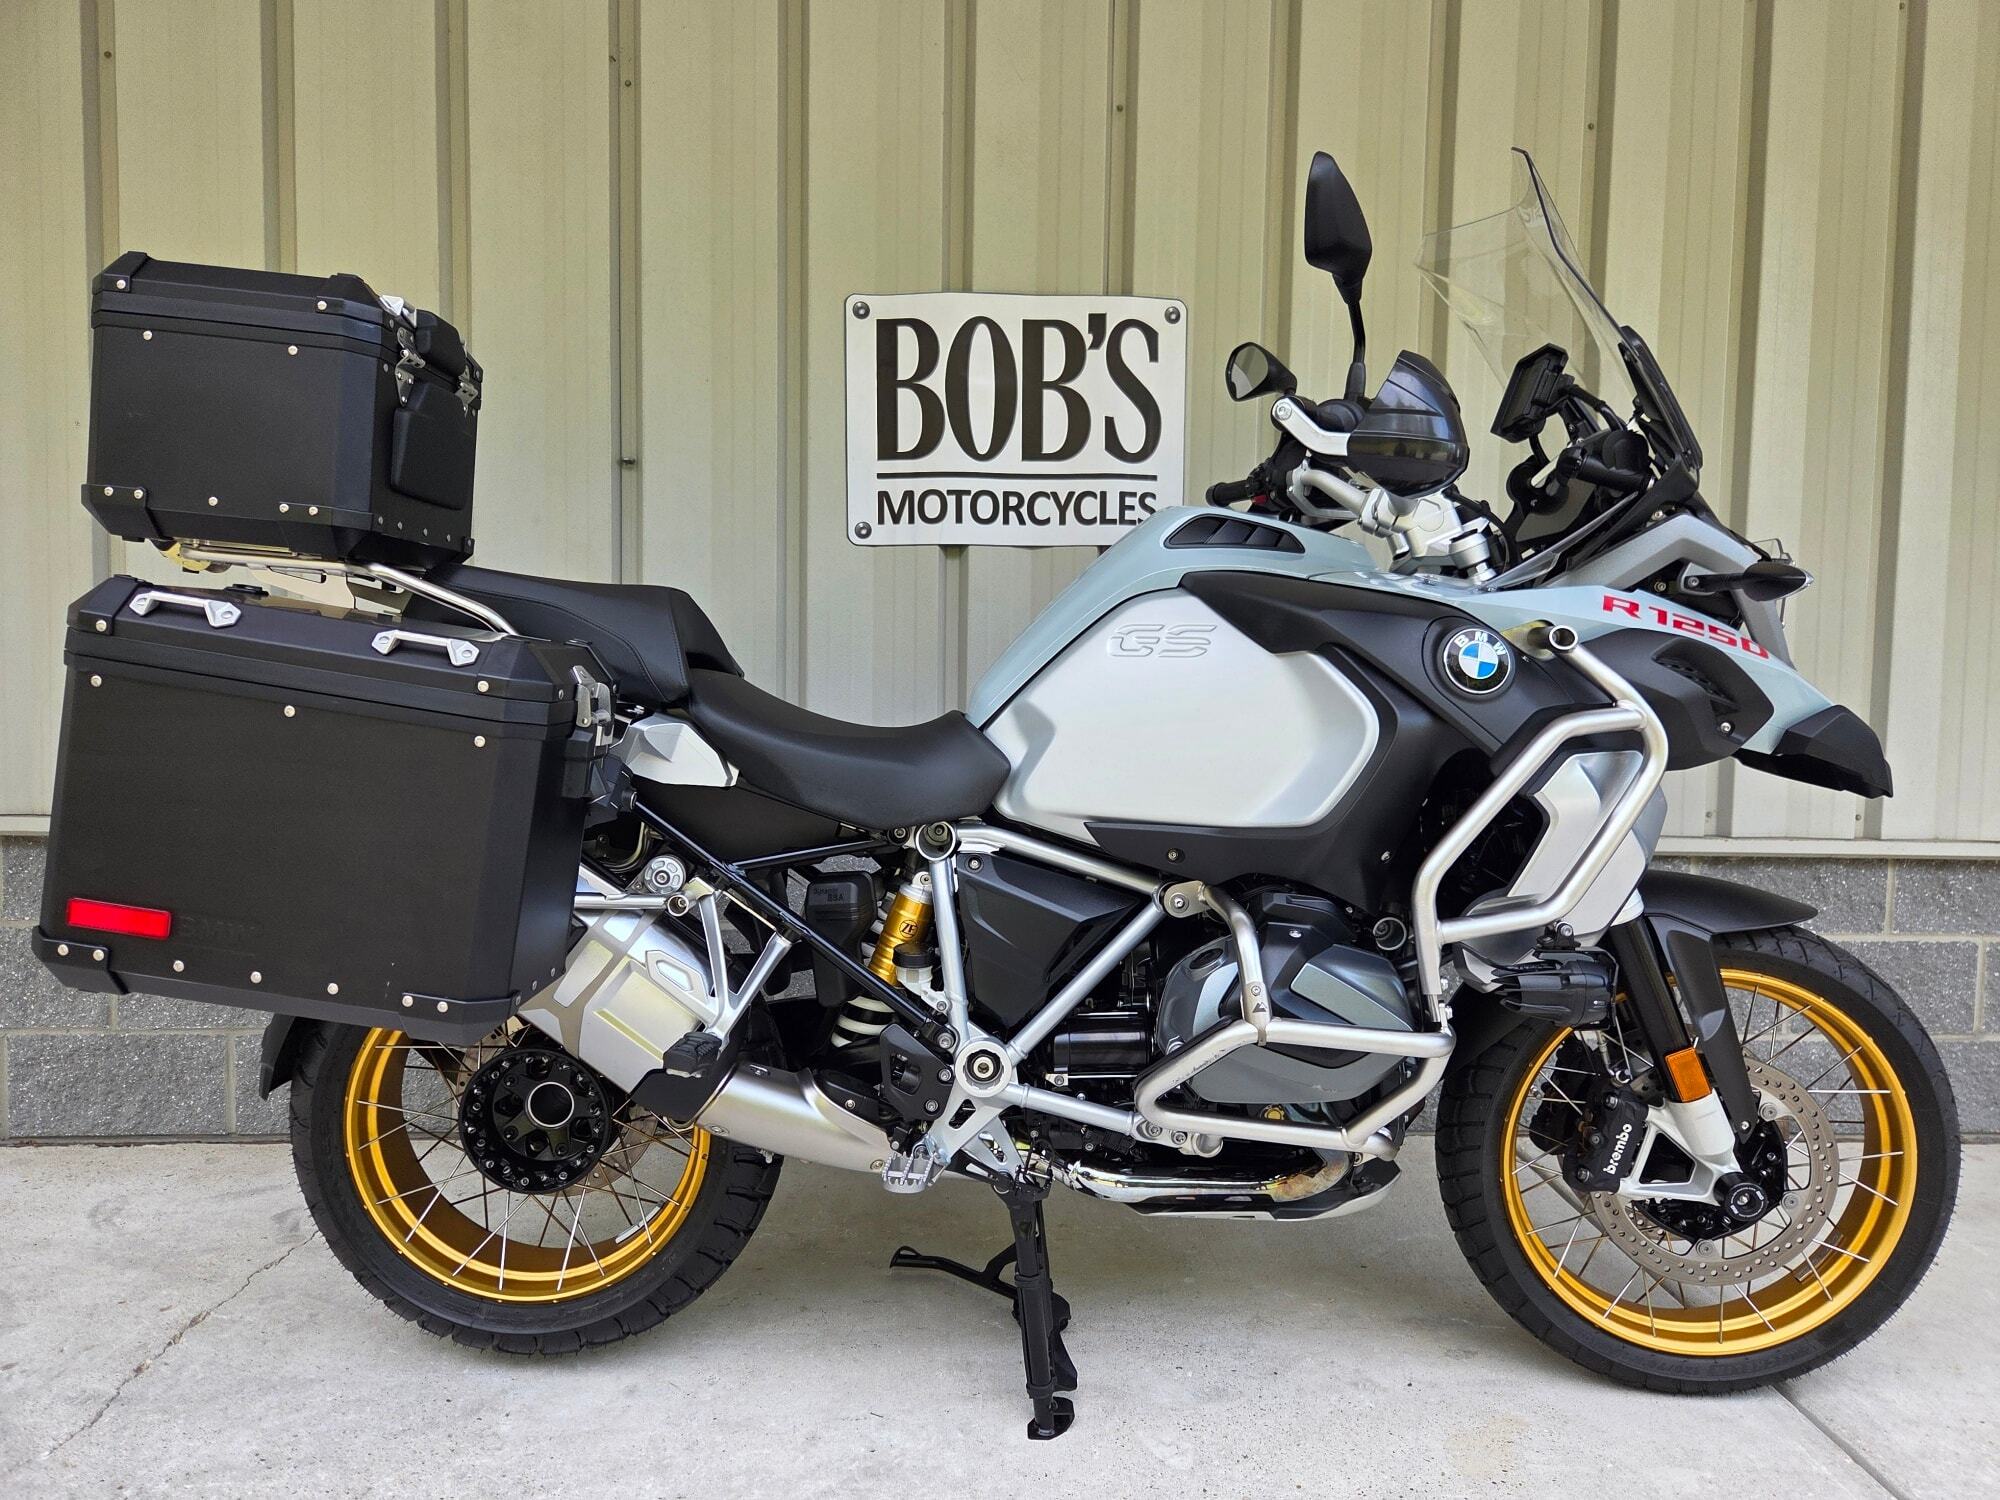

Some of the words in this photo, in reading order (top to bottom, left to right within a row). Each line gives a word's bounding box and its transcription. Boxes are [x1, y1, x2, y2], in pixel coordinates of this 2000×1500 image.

[876, 312, 1162, 464] BOB'S
[876, 489, 1157, 527] MOTORCYCLES
[1107, 624, 1218, 658] GS
[1453, 630, 1508, 657] BMW
[1603, 1123, 1633, 1175] brembo
